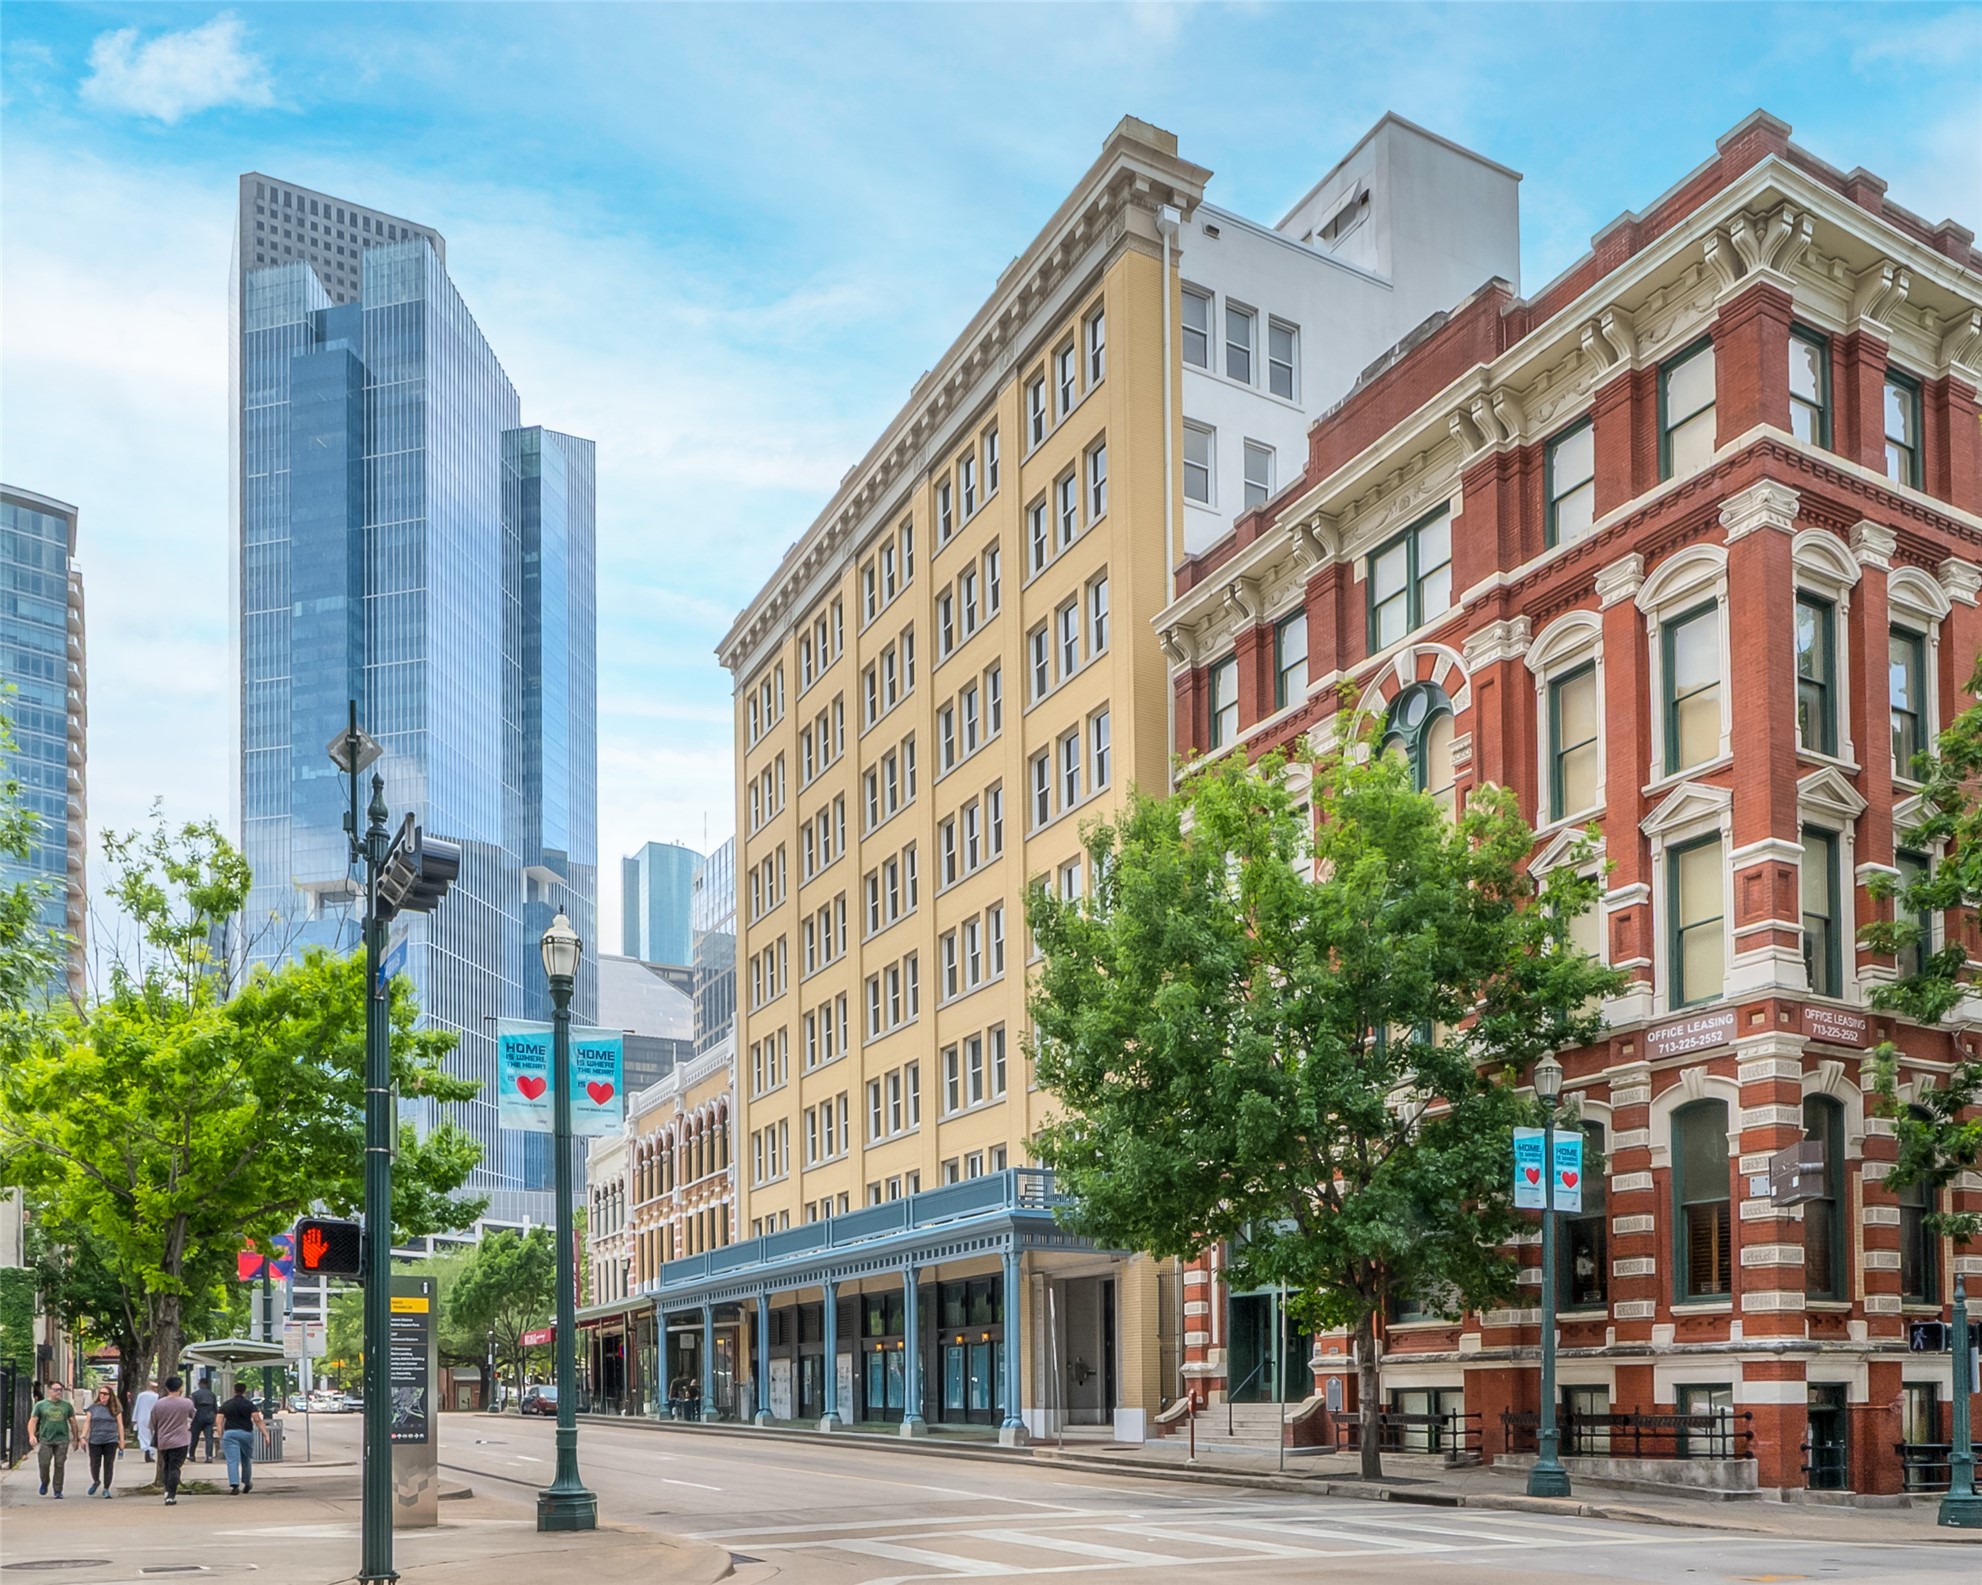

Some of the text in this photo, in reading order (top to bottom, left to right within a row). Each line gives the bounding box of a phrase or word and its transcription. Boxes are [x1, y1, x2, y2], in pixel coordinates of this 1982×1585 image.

[1647, 1013, 1735, 1043] OFFICE LEASING
[1804, 1007, 1867, 1031] OFFICE LEASING
[1658, 1031, 1724, 1054] 713-225-2552
[1812, 1023, 1858, 1042] 713-225-2552
[506, 1042, 546, 1055] HOME
[577, 1048, 615, 1061] HOME
